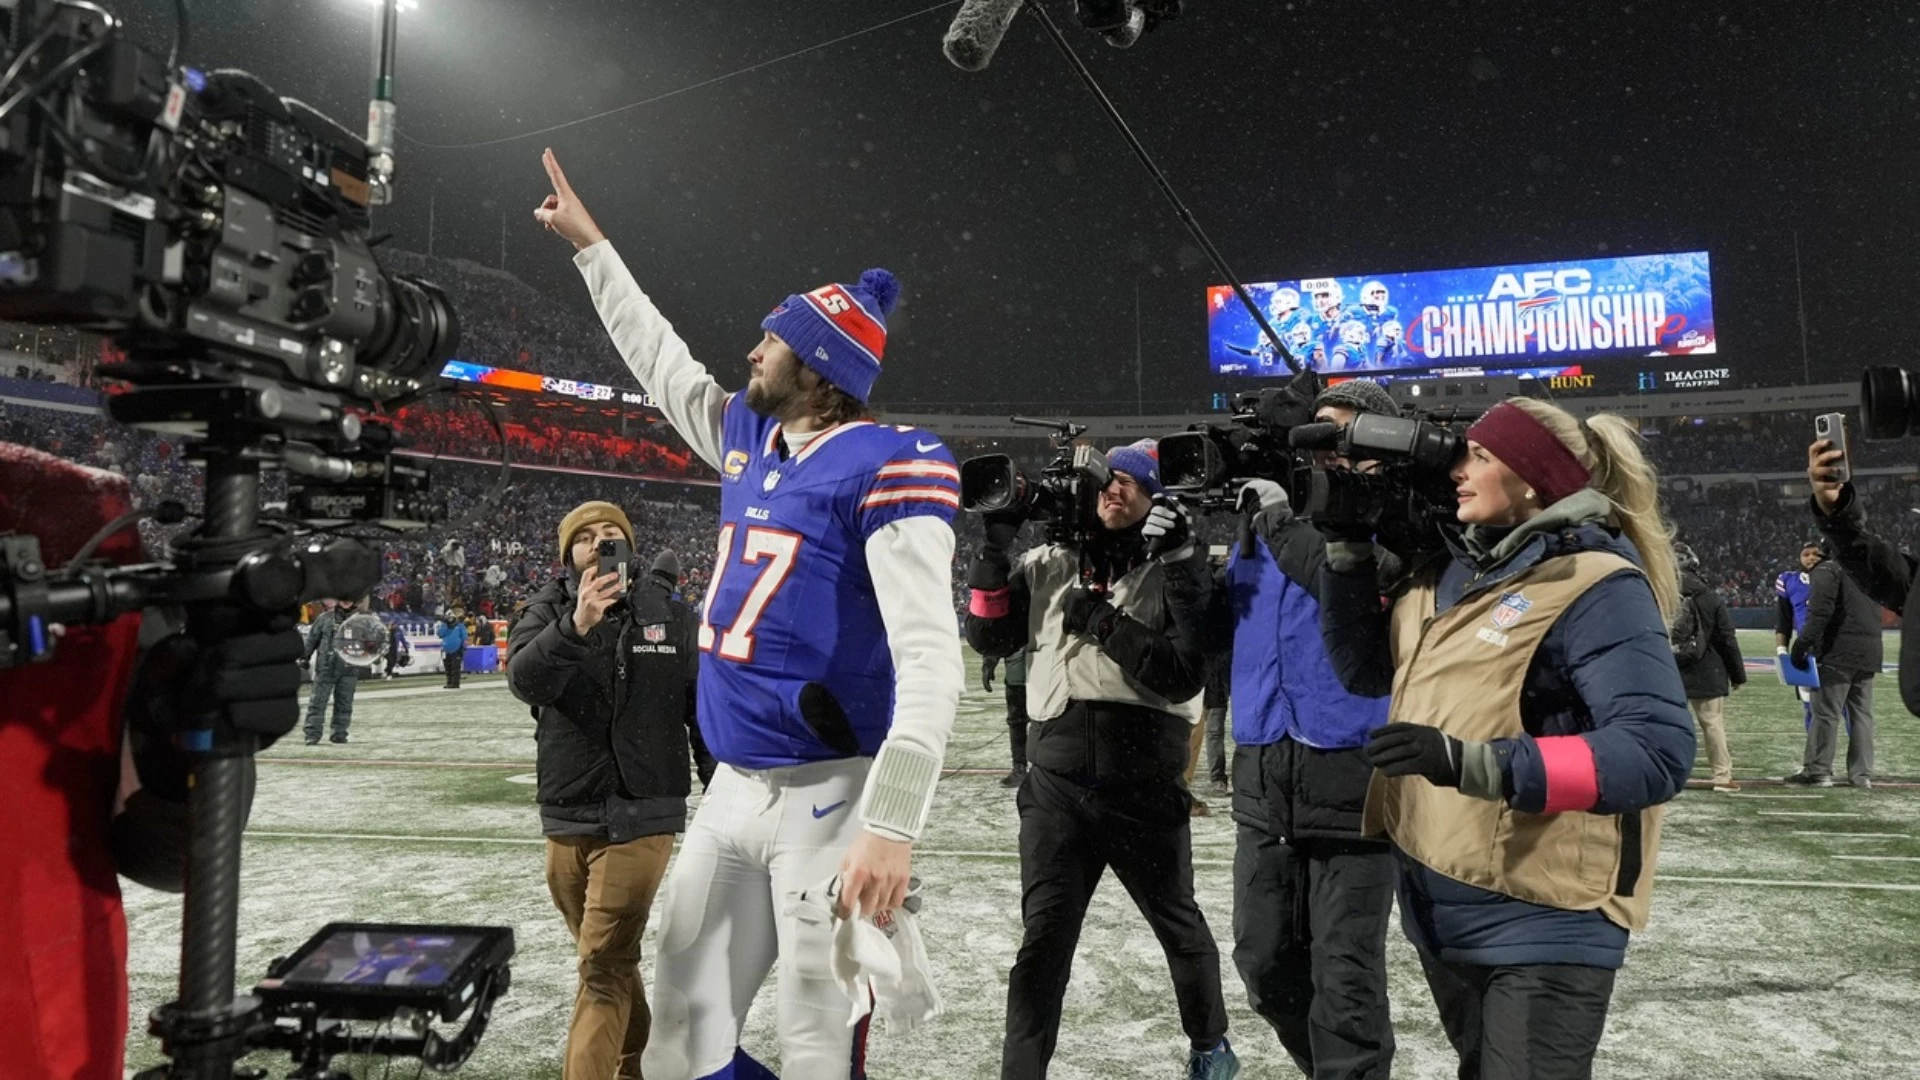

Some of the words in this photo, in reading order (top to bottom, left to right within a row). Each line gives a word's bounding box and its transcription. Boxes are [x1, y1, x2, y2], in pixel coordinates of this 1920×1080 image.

[1305, 280, 1330, 291] 0:00
[1487, 268, 1592, 300] AFC
[1446, 294, 1484, 304] NEXT
[1596, 283, 1636, 293] STOP
[1421, 291, 1667, 360] CHAMPIONSHIP
[1550, 374, 1595, 389] HUNT
[1664, 368, 1731, 382] IMAGINE
[561, 382, 574, 392] 25
[1675, 380, 1720, 388] STAFFING
[597, 388, 609, 397] 27
[622, 392, 642, 404] 0:00
[724, 449, 749, 475] C
[744, 506, 770, 521] BILLS
[697, 522, 804, 663] 17
[632, 645, 656, 653] SOCIAL
[657, 645, 677, 653] MEDIA
